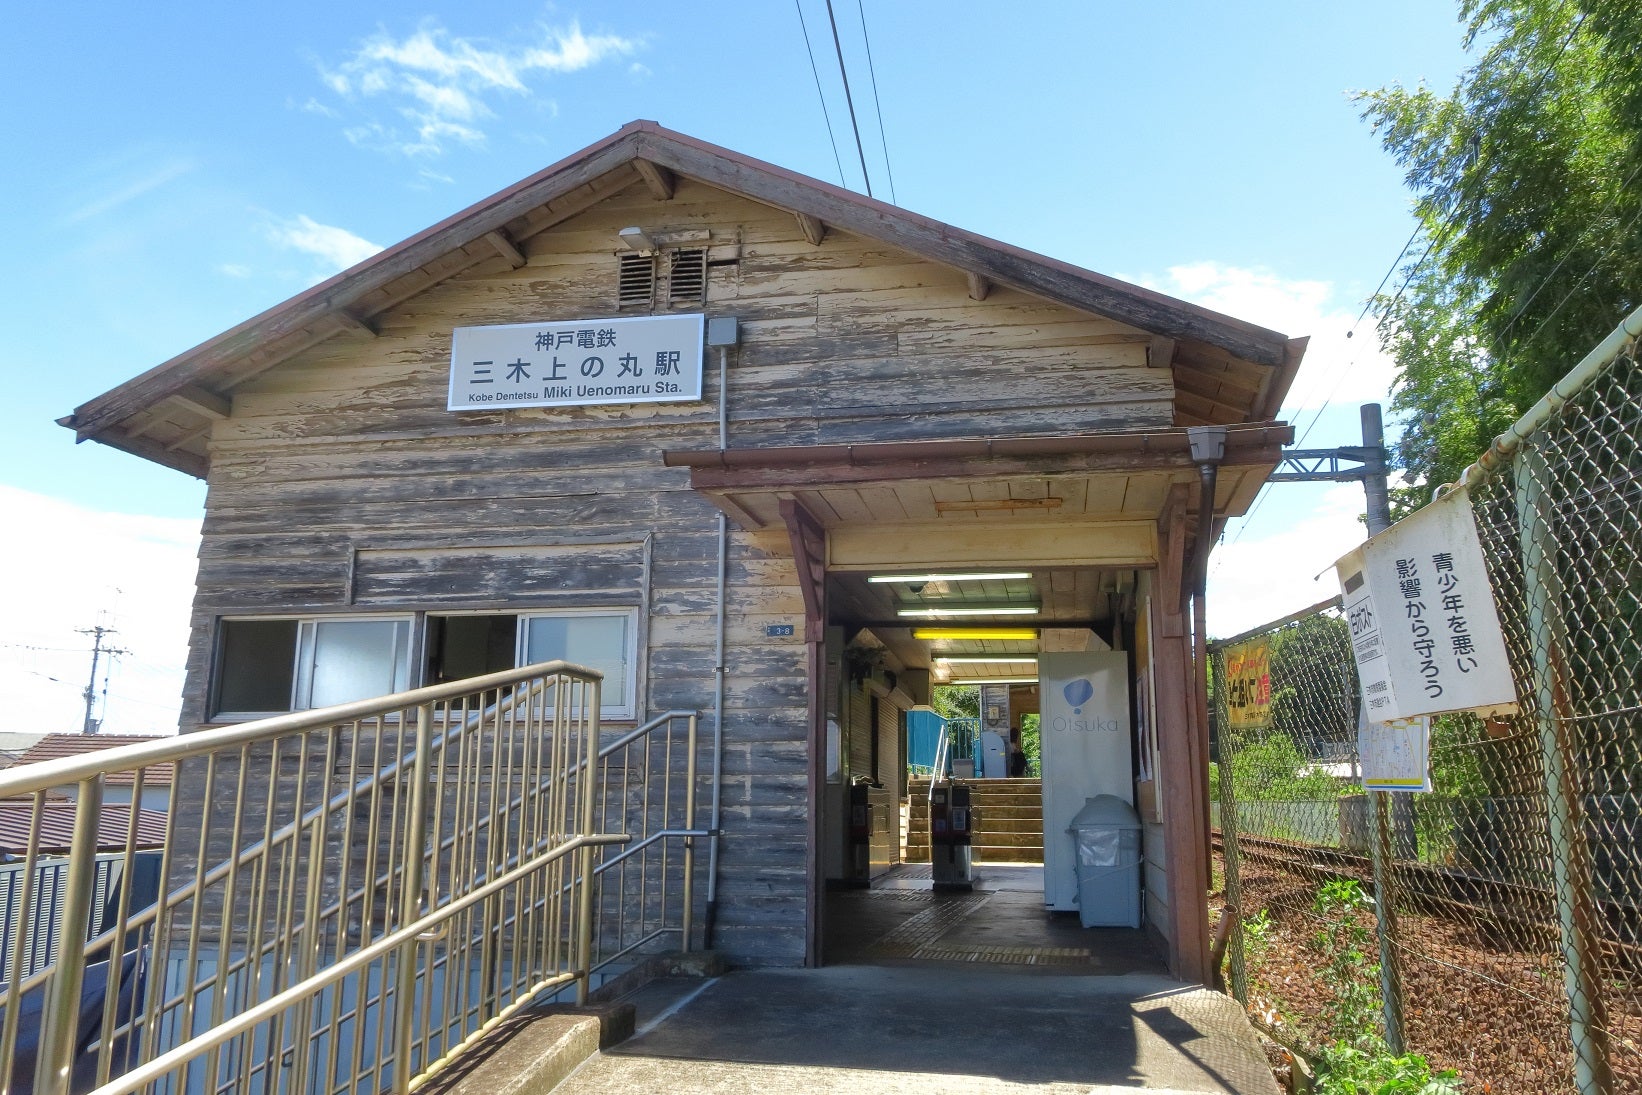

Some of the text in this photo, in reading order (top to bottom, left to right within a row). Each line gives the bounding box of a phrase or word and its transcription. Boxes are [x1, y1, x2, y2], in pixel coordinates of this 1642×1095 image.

[535, 328, 617, 351] 神戸電鉄
[470, 351, 681, 384] 三木上の丸駅
[468, 381, 682, 402] Kobe Dentetsu Miki Uenomaru Sta.
[1350, 604, 1373, 636] 白ポスト
[1432, 552, 1478, 673] 青少年を悪い
[776, 627, 790, 635] 3-8
[1396, 558, 1443, 699] 影響から守ろう
[1053, 716, 1118, 732] Otsuka
